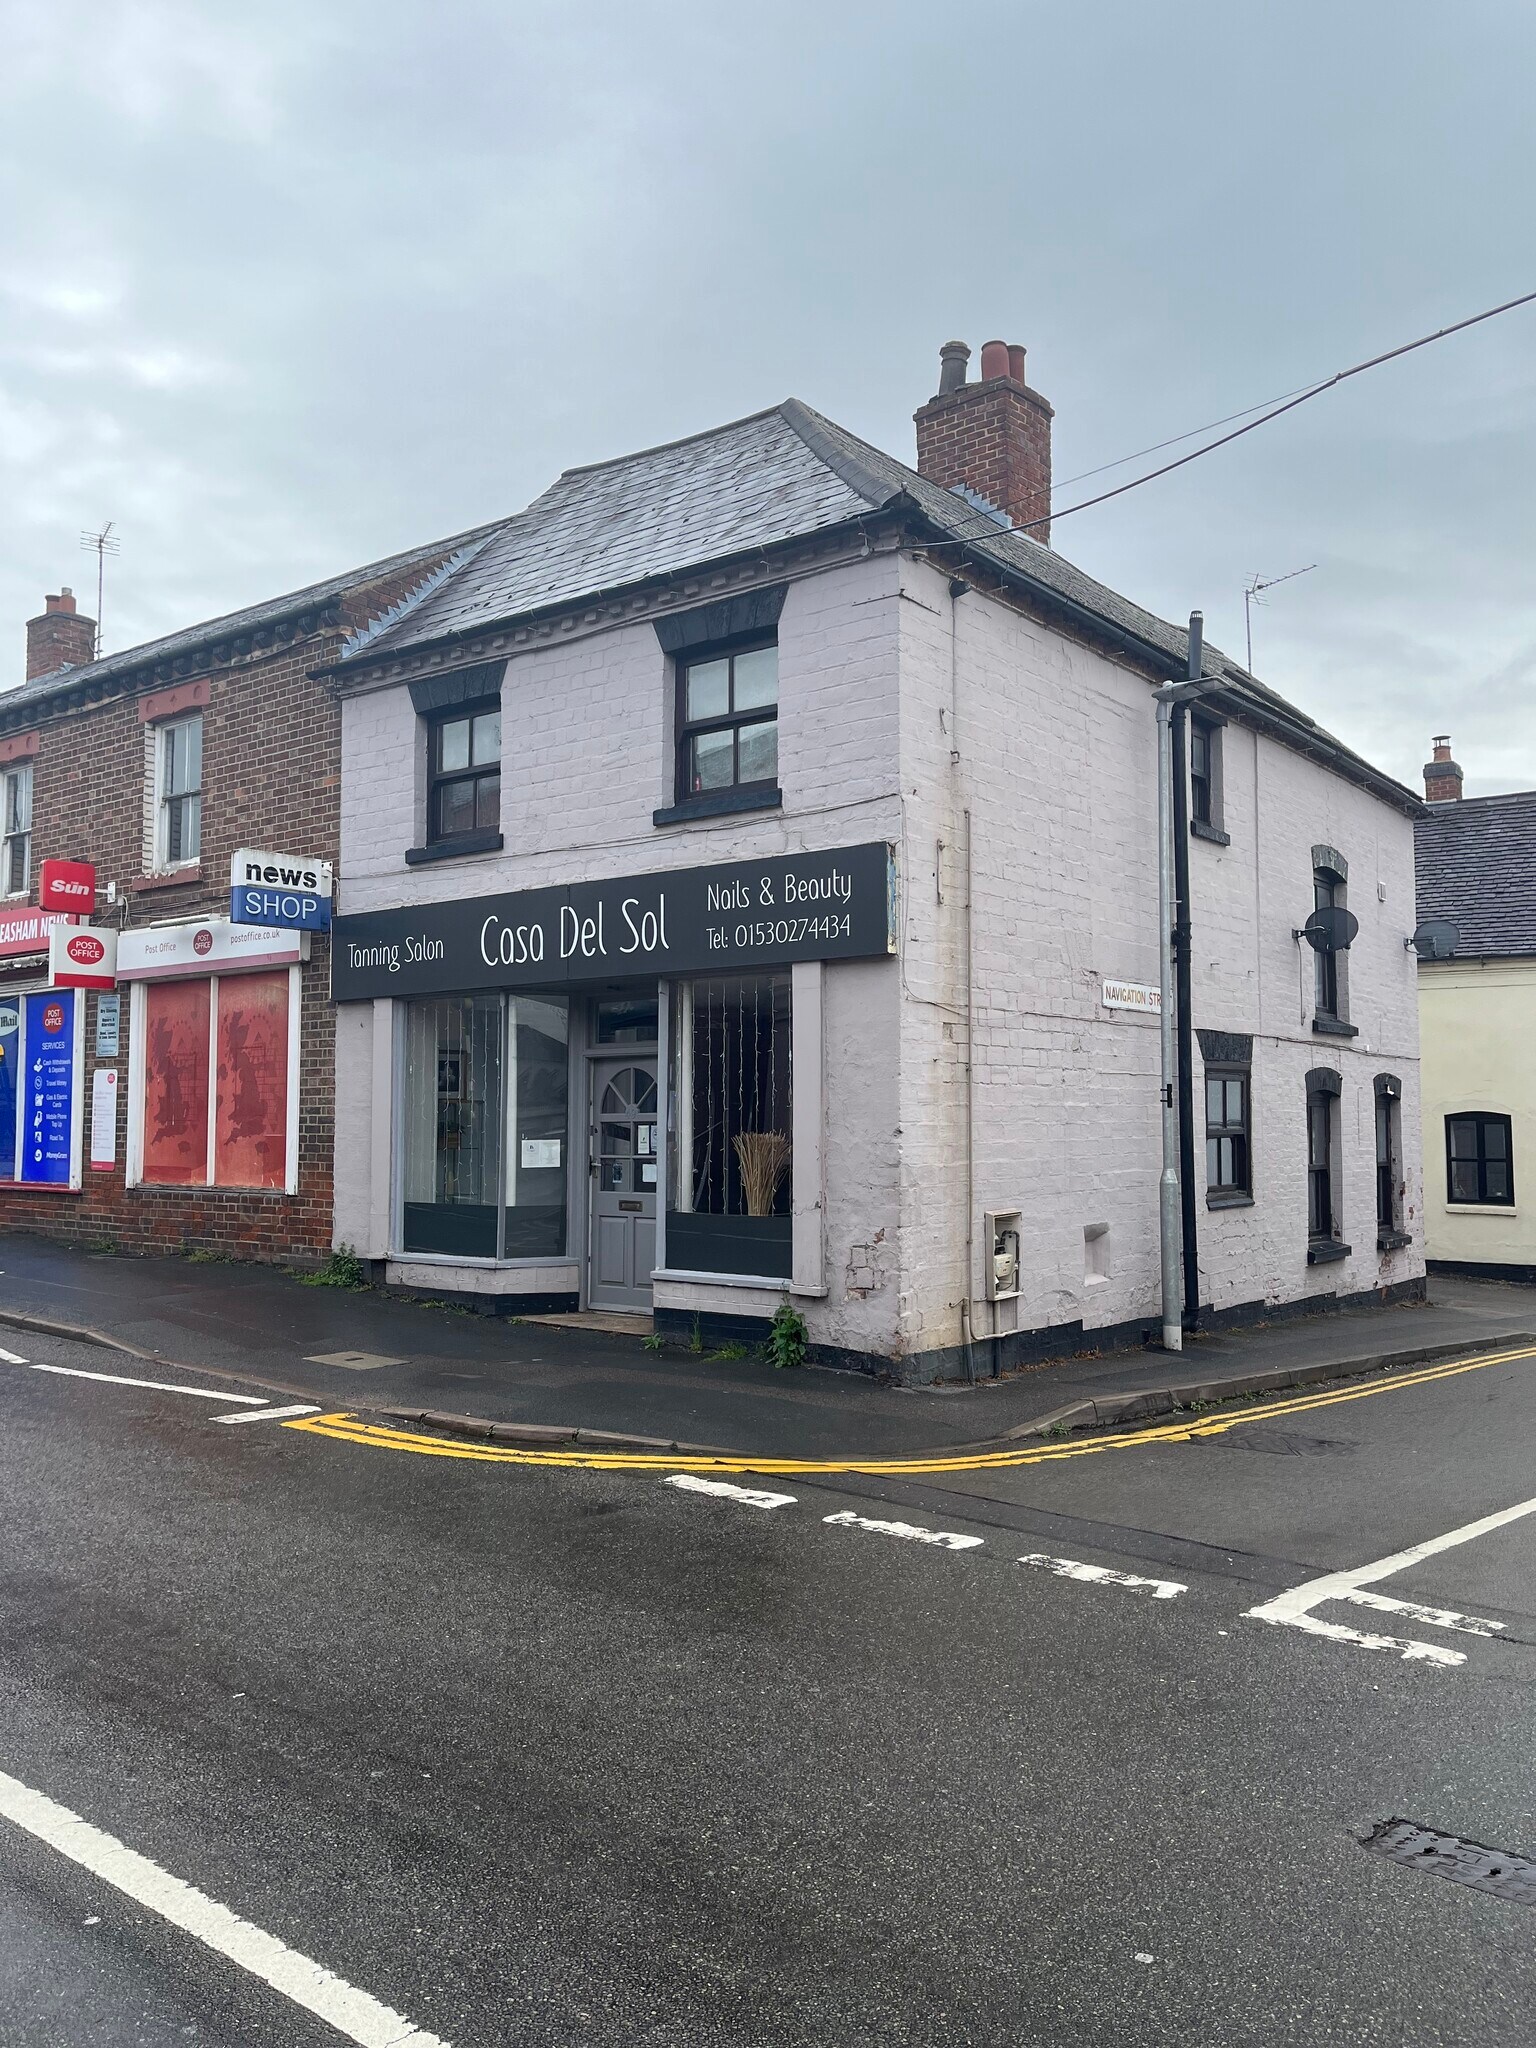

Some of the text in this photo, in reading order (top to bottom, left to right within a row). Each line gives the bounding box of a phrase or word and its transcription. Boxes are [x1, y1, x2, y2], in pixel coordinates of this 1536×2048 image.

[246, 863, 317, 888] news
[50, 879, 89, 895] Sun
[707, 869, 852, 911] Nails & Beauty
[245, 892, 318, 920] SHOP
[0, 918, 38, 944] EASHAM
[197, 933, 210, 942] POST
[230, 929, 281, 945] postoffice.co.uk
[480, 894, 670, 966] Casa Del Sol
[706, 913, 850, 949] Tel: 01530274434
[70, 949, 100, 958] OFFICE
[75, 941, 97, 950] POST
[145, 942, 177, 954] Post Office
[194, 941, 212, 950] OFFICE
[347, 934, 444, 972] Tanning Salon
[1105, 986, 1146, 1004] NAVIGATION
[47, 1009, 60, 1018] POST
[44, 1018, 62, 1027] OFFICE
[41, 1041, 66, 1051] SERVICES
